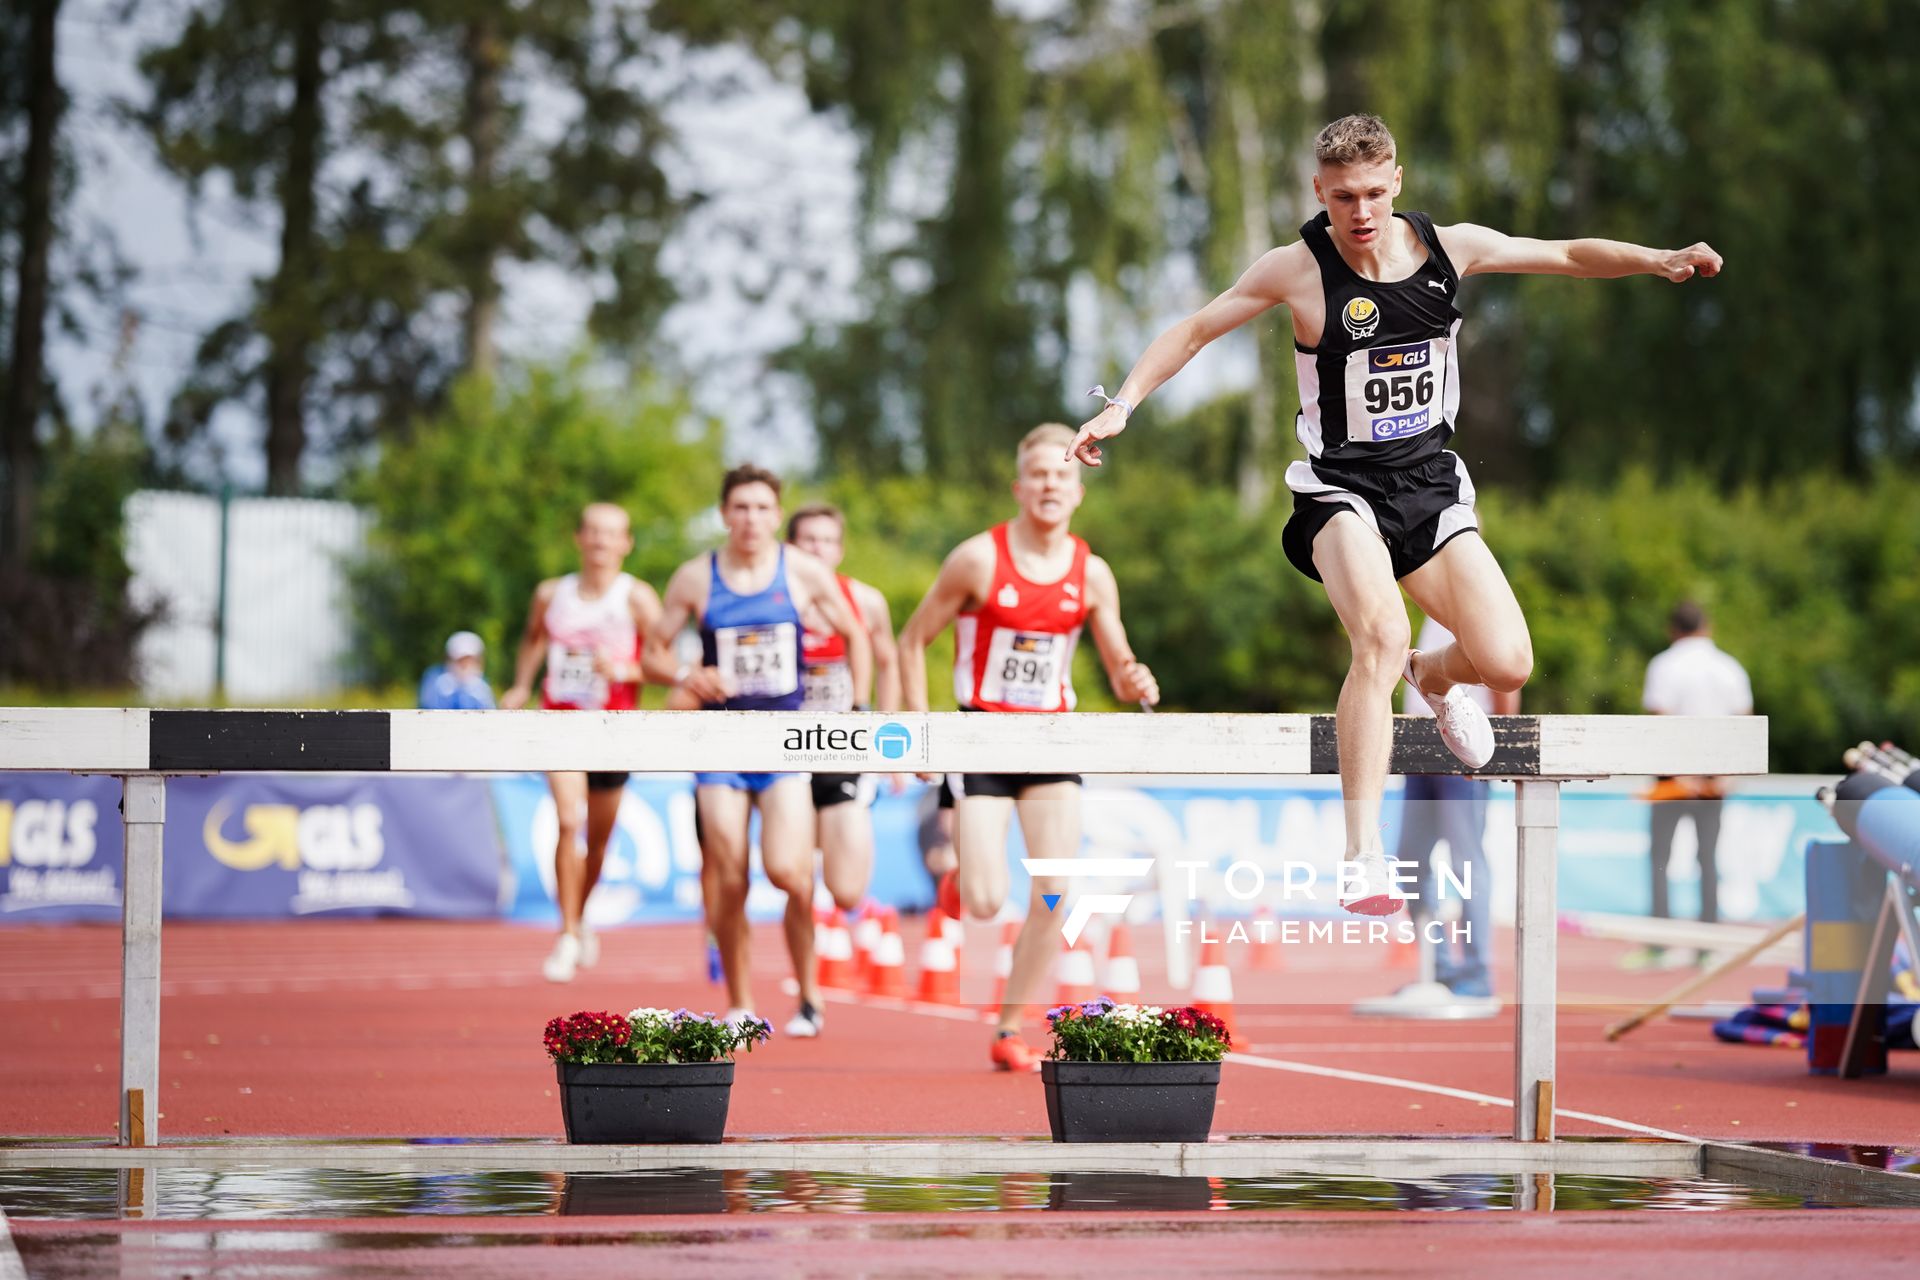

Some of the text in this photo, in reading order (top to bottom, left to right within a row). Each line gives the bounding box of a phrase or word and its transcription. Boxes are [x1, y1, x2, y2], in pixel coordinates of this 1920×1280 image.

[1403, 349, 1427, 366] GLS
[1364, 370, 1434, 414] 956
[1398, 412, 1428, 429] PLAN
[783, 723, 868, 751] artec
[840, 752, 868, 761] GmbH
[12, 798, 98, 868] GLS
[297, 802, 385, 871] GLS
